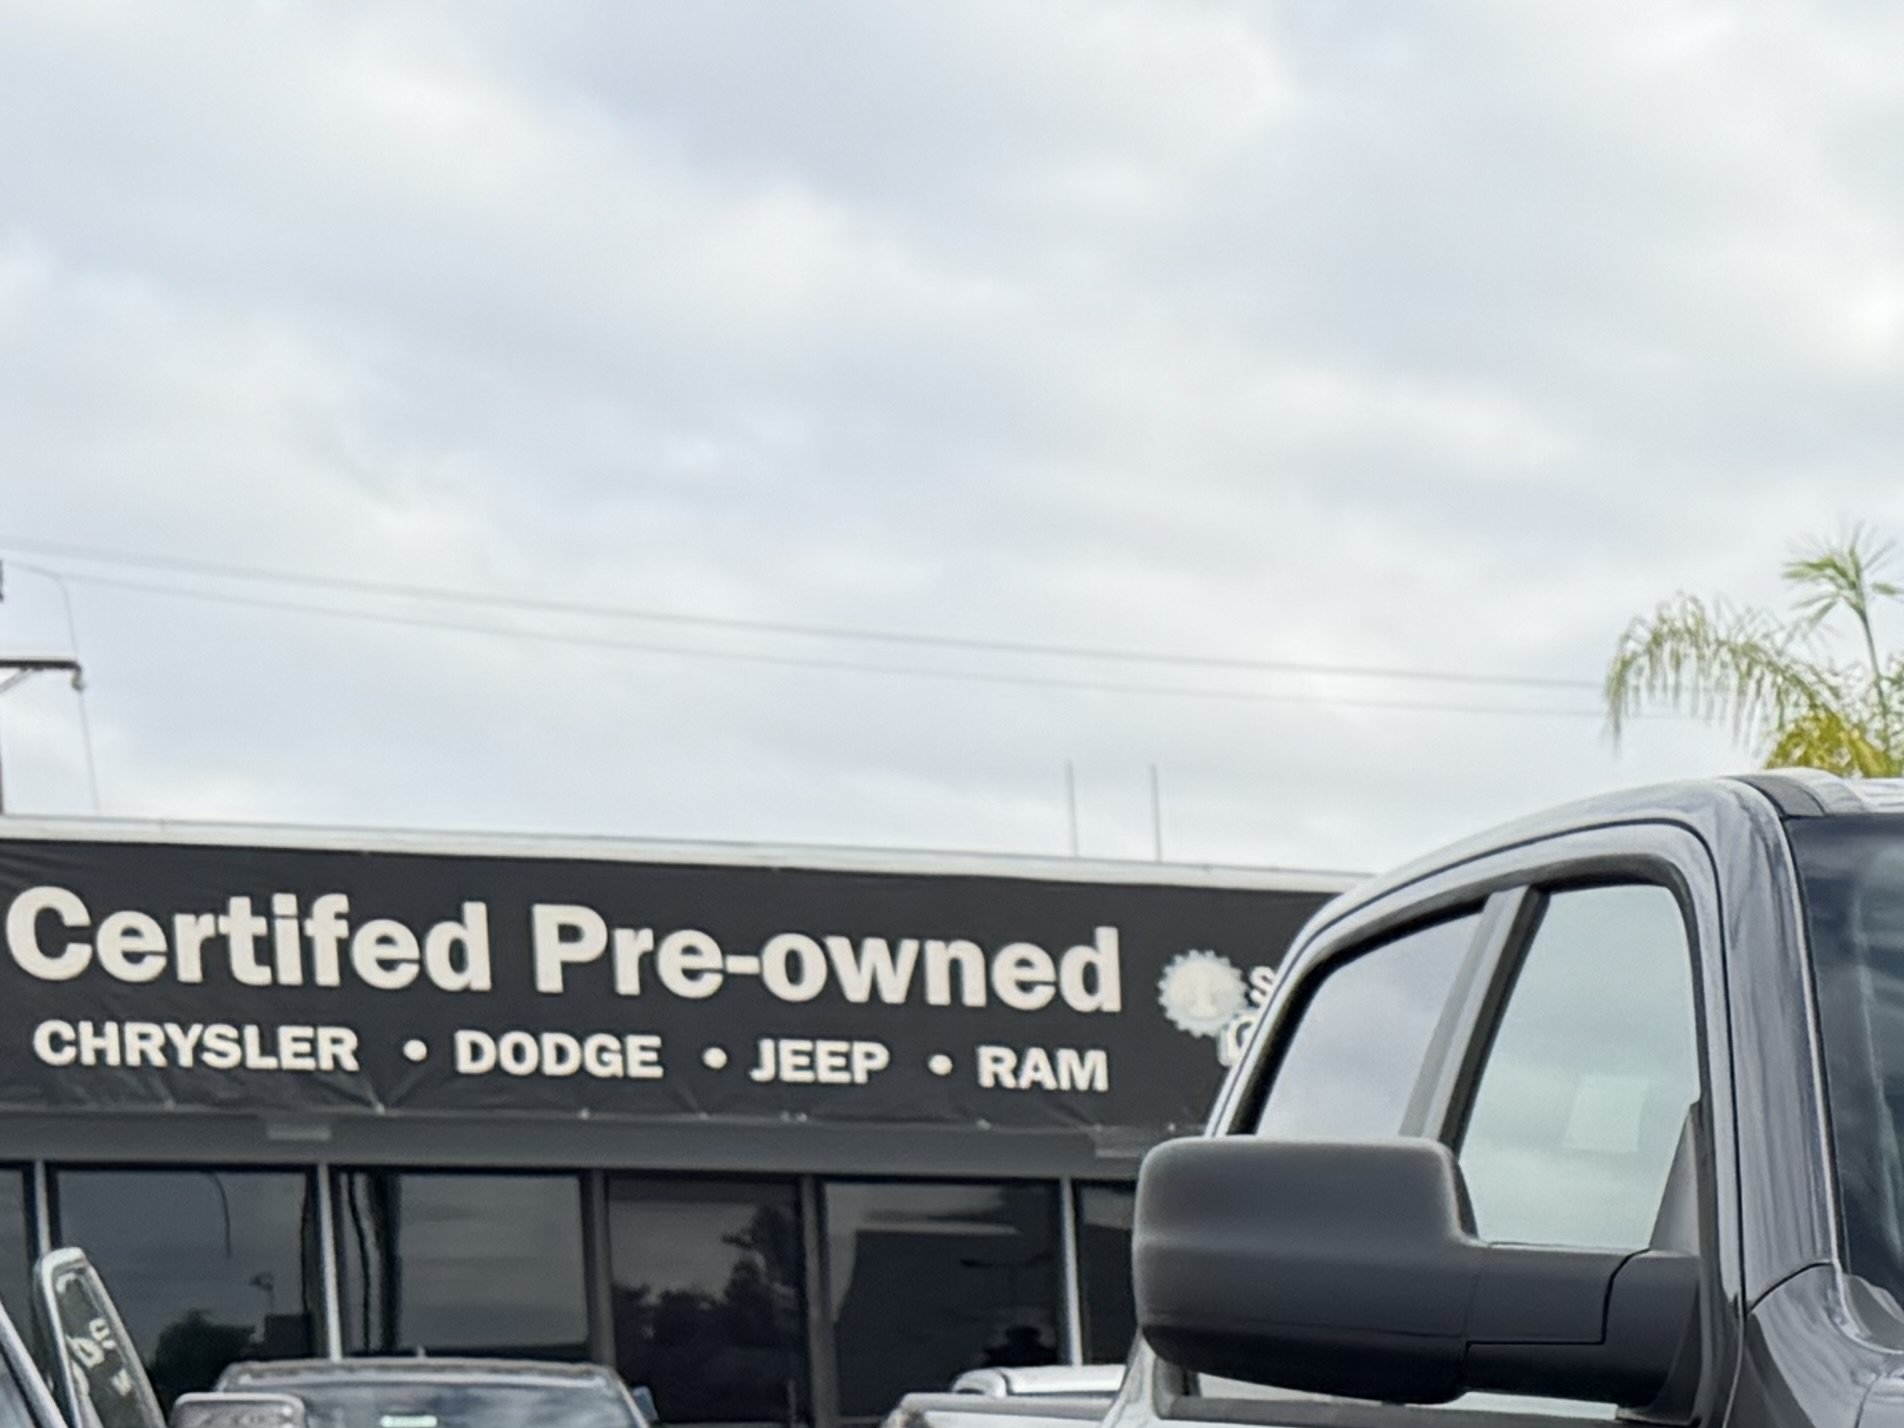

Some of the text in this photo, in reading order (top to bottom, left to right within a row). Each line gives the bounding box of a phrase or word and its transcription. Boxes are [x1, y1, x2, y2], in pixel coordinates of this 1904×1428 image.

[6, 885, 1122, 1013] Certifed Pre-owned
[32, 1018, 1109, 1092] CHRYSLER DODGE JEEP RAM
